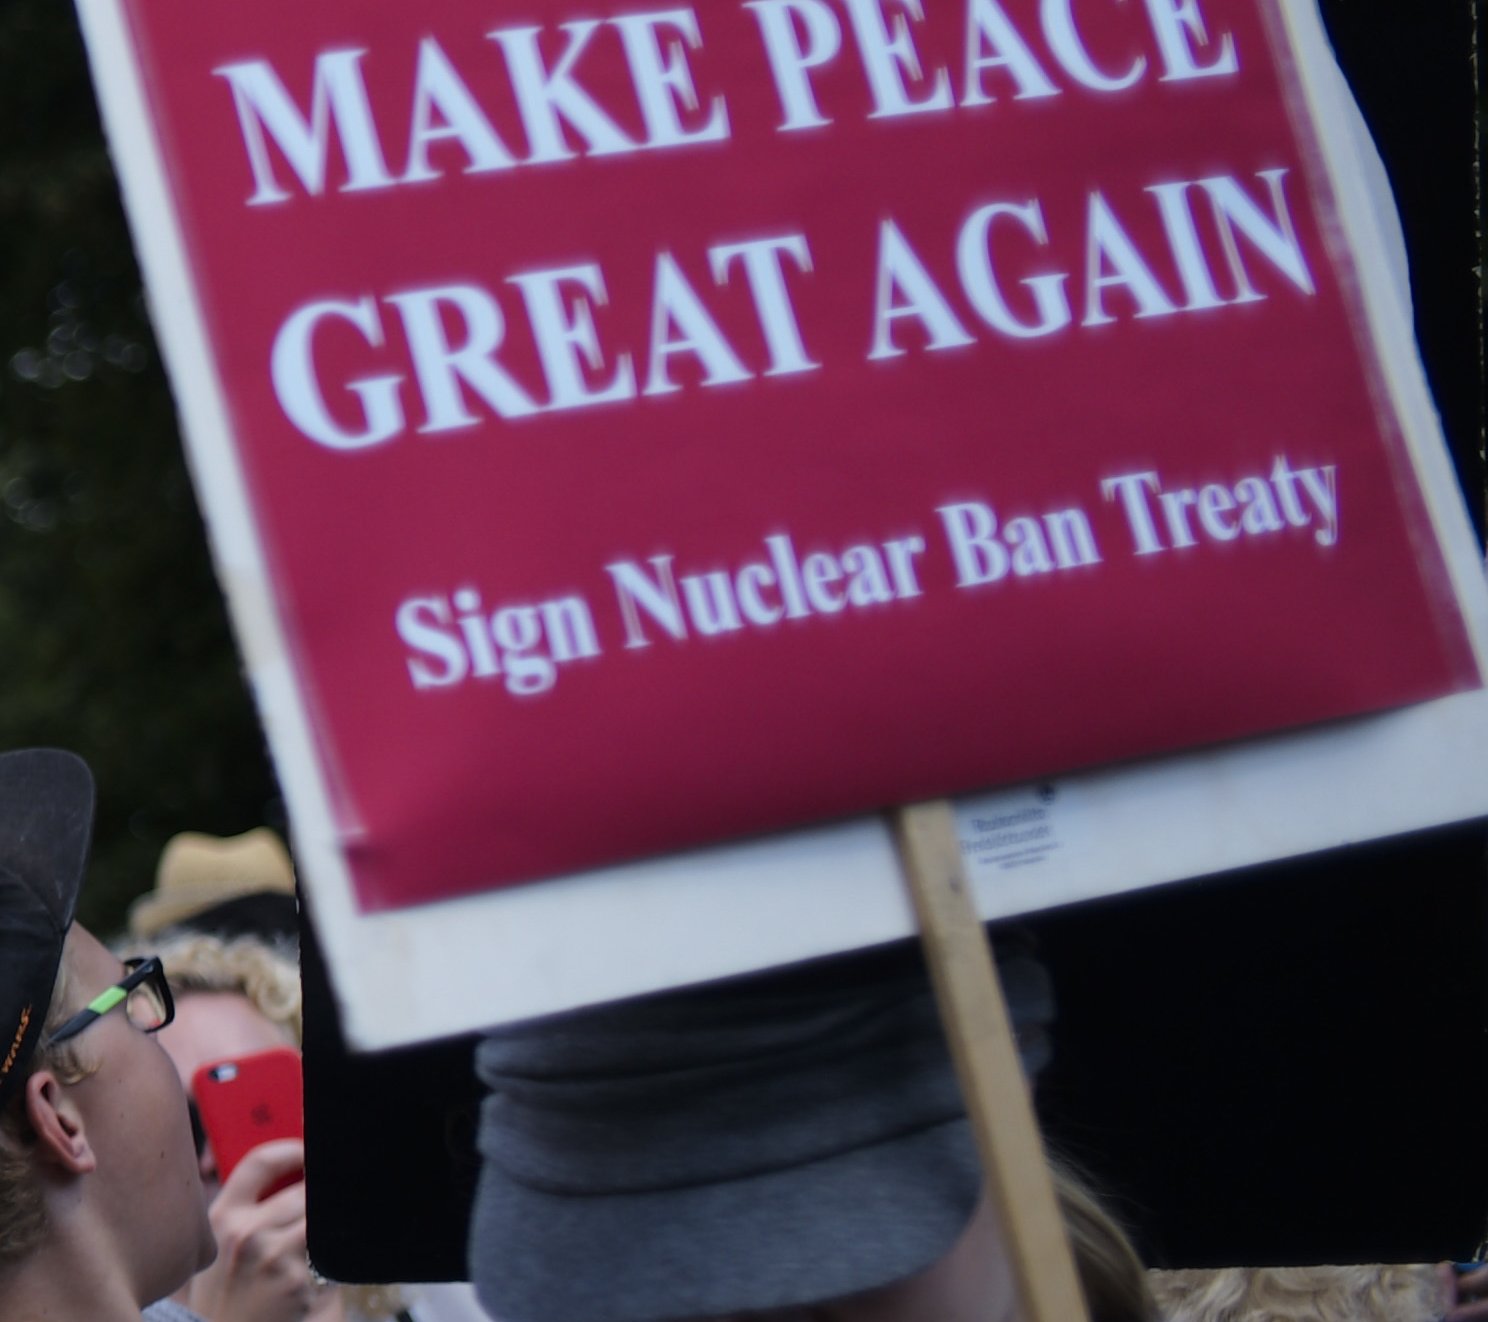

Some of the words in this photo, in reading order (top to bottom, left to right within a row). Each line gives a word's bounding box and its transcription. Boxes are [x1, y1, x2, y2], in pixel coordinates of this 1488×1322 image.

[213, 8, 730, 206] MAKE
[271, 234, 819, 450] GREAT
[867, 168, 1317, 361] AGAIN
[395, 587, 601, 696] Sign
[605, 533, 925, 649] Nuclear
[935, 477, 1104, 588] Ban
[1103, 455, 1338, 554] Treaty
